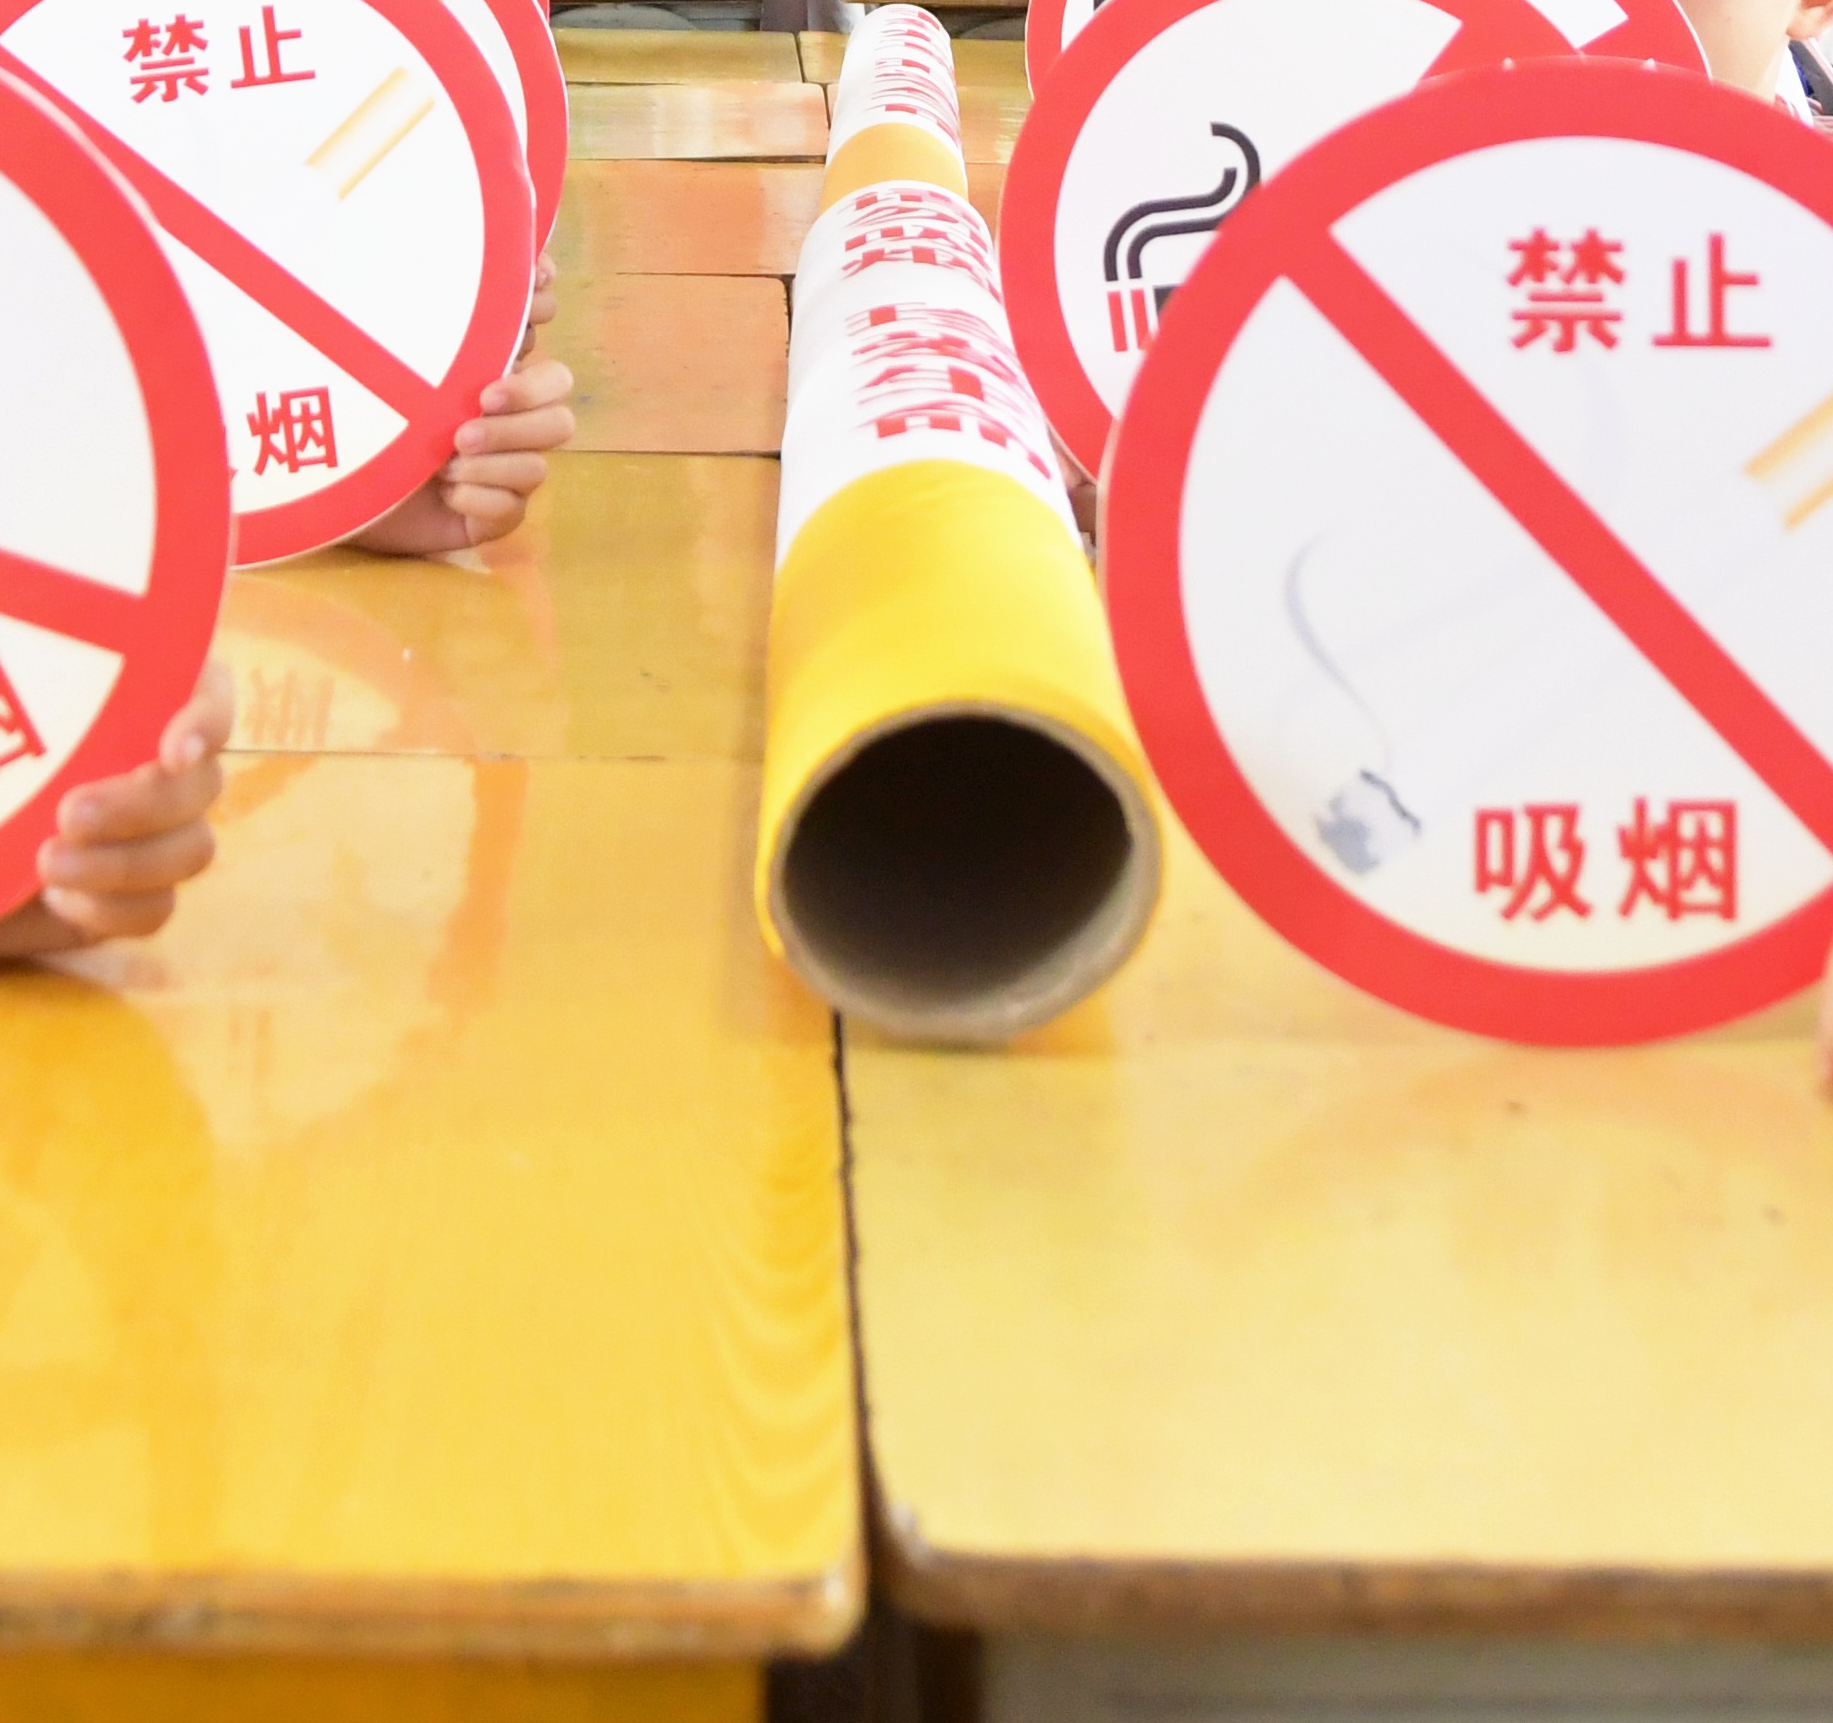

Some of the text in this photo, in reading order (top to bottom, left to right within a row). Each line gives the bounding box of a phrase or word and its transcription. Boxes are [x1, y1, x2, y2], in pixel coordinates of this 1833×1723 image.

[122, 5, 316, 104] 禁止
[1506, 228, 1774, 353] 禁止
[1472, 799, 1740, 922] 吸烟
